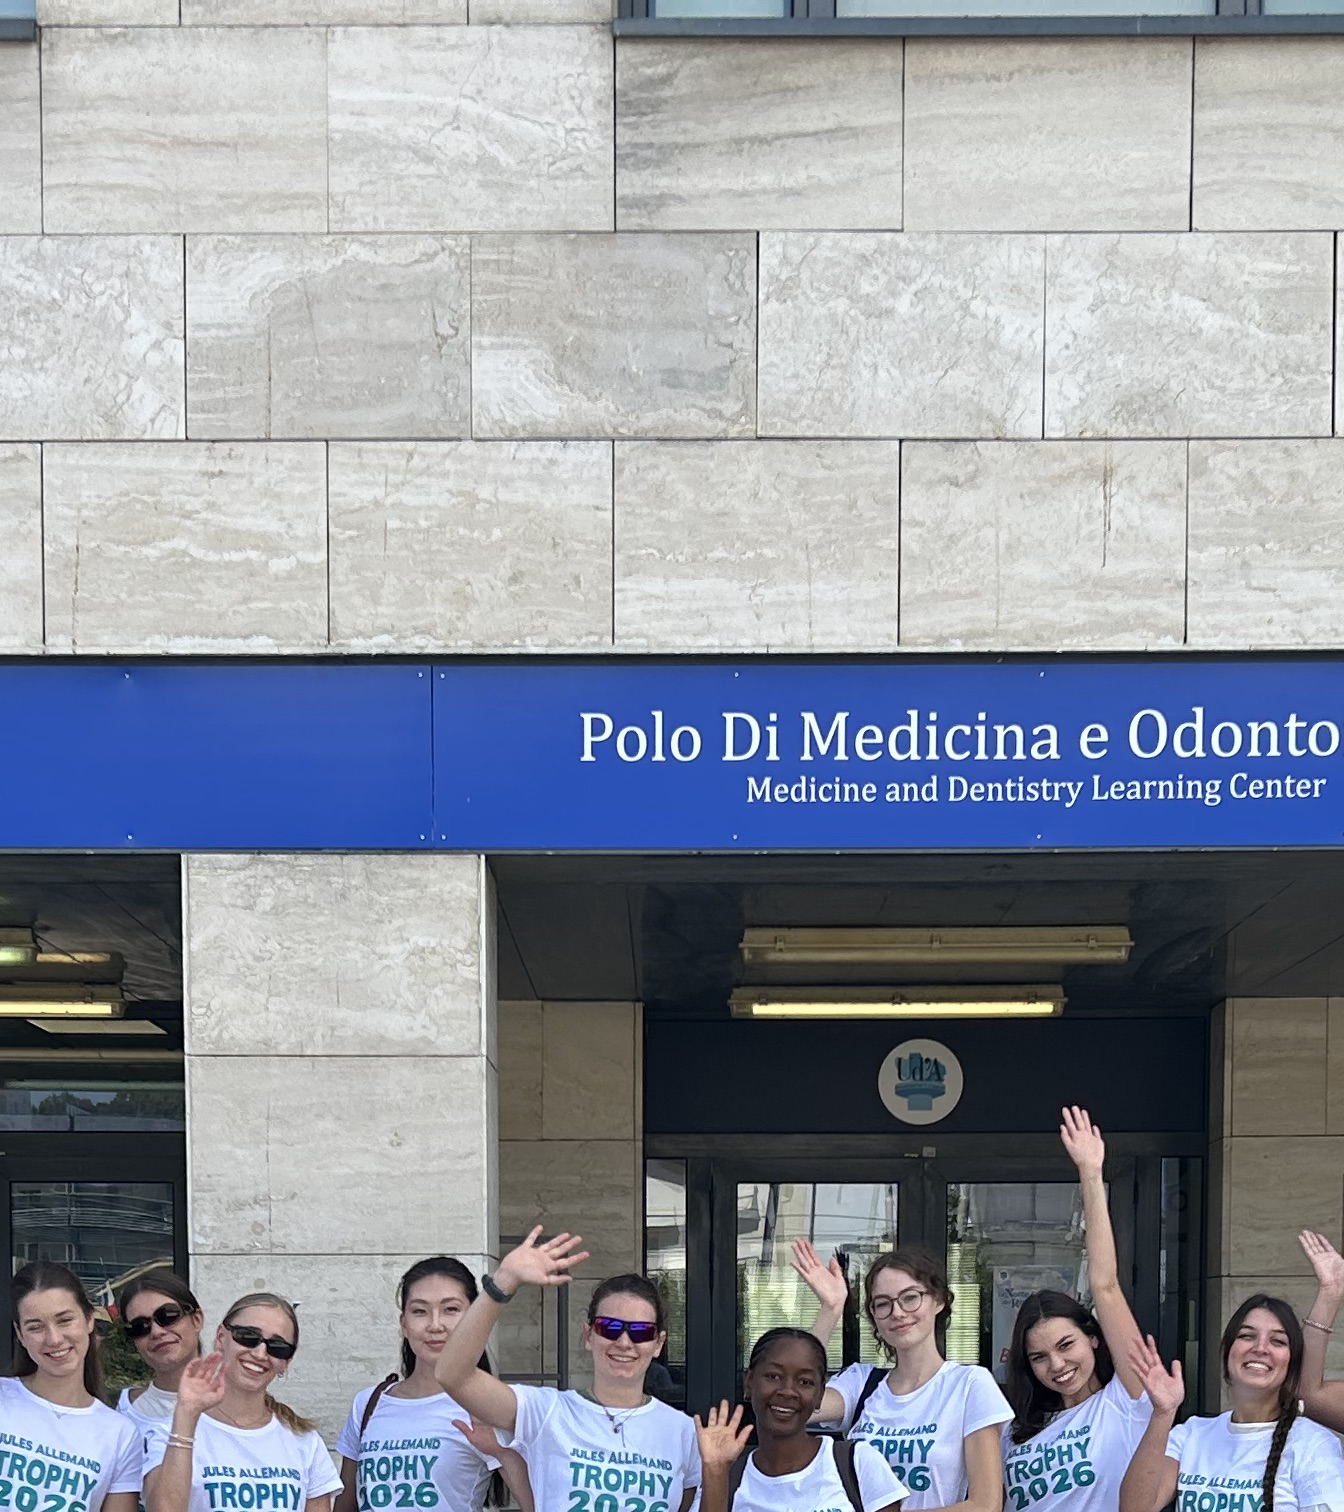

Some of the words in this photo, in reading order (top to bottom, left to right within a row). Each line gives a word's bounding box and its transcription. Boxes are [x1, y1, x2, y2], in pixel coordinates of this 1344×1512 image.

[579, 710, 702, 762] Polo
[721, 712, 781, 761] Di
[800, 709, 1061, 761] Medicina
[1079, 723, 1109, 760] e
[746, 775, 877, 803] Medicine
[885, 774, 939, 802] and
[948, 775, 1084, 808] Dentistry
[1091, 773, 1223, 807] Learning
[1229, 772, 1327, 799] Center
[381, 1437, 441, 1450] ALLEMAND
[36, 1444, 101, 1474] ALLEMAND
[202, 1466, 236, 1478] JULES
[239, 1466, 301, 1481] ALLEMAND
[569, 1448, 605, 1462] JULES
[608, 1451, 673, 1471] ALLEMAND
[569, 1461, 673, 1499] TROPHY
[1009, 1461, 1095, 1511] 2026
[204, 1482, 302, 1510] TROPHY
